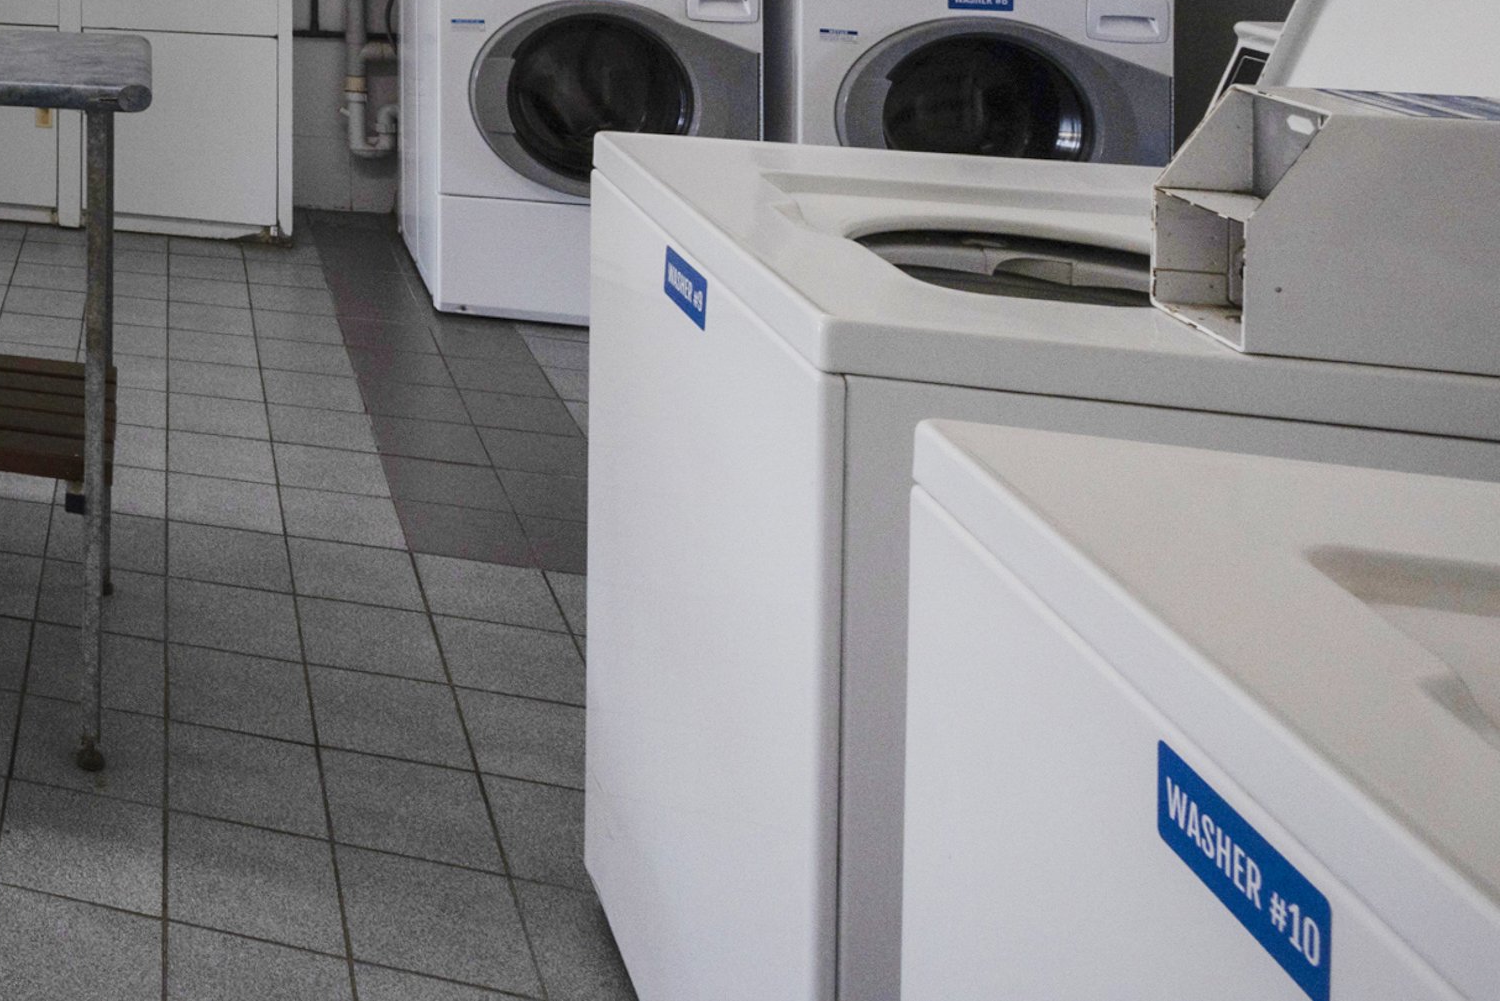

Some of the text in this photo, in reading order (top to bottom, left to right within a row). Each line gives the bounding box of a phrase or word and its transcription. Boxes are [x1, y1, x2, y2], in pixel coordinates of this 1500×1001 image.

[667, 262, 693, 304] WASHER
[1166, 775, 1321, 968] WASHER #10
